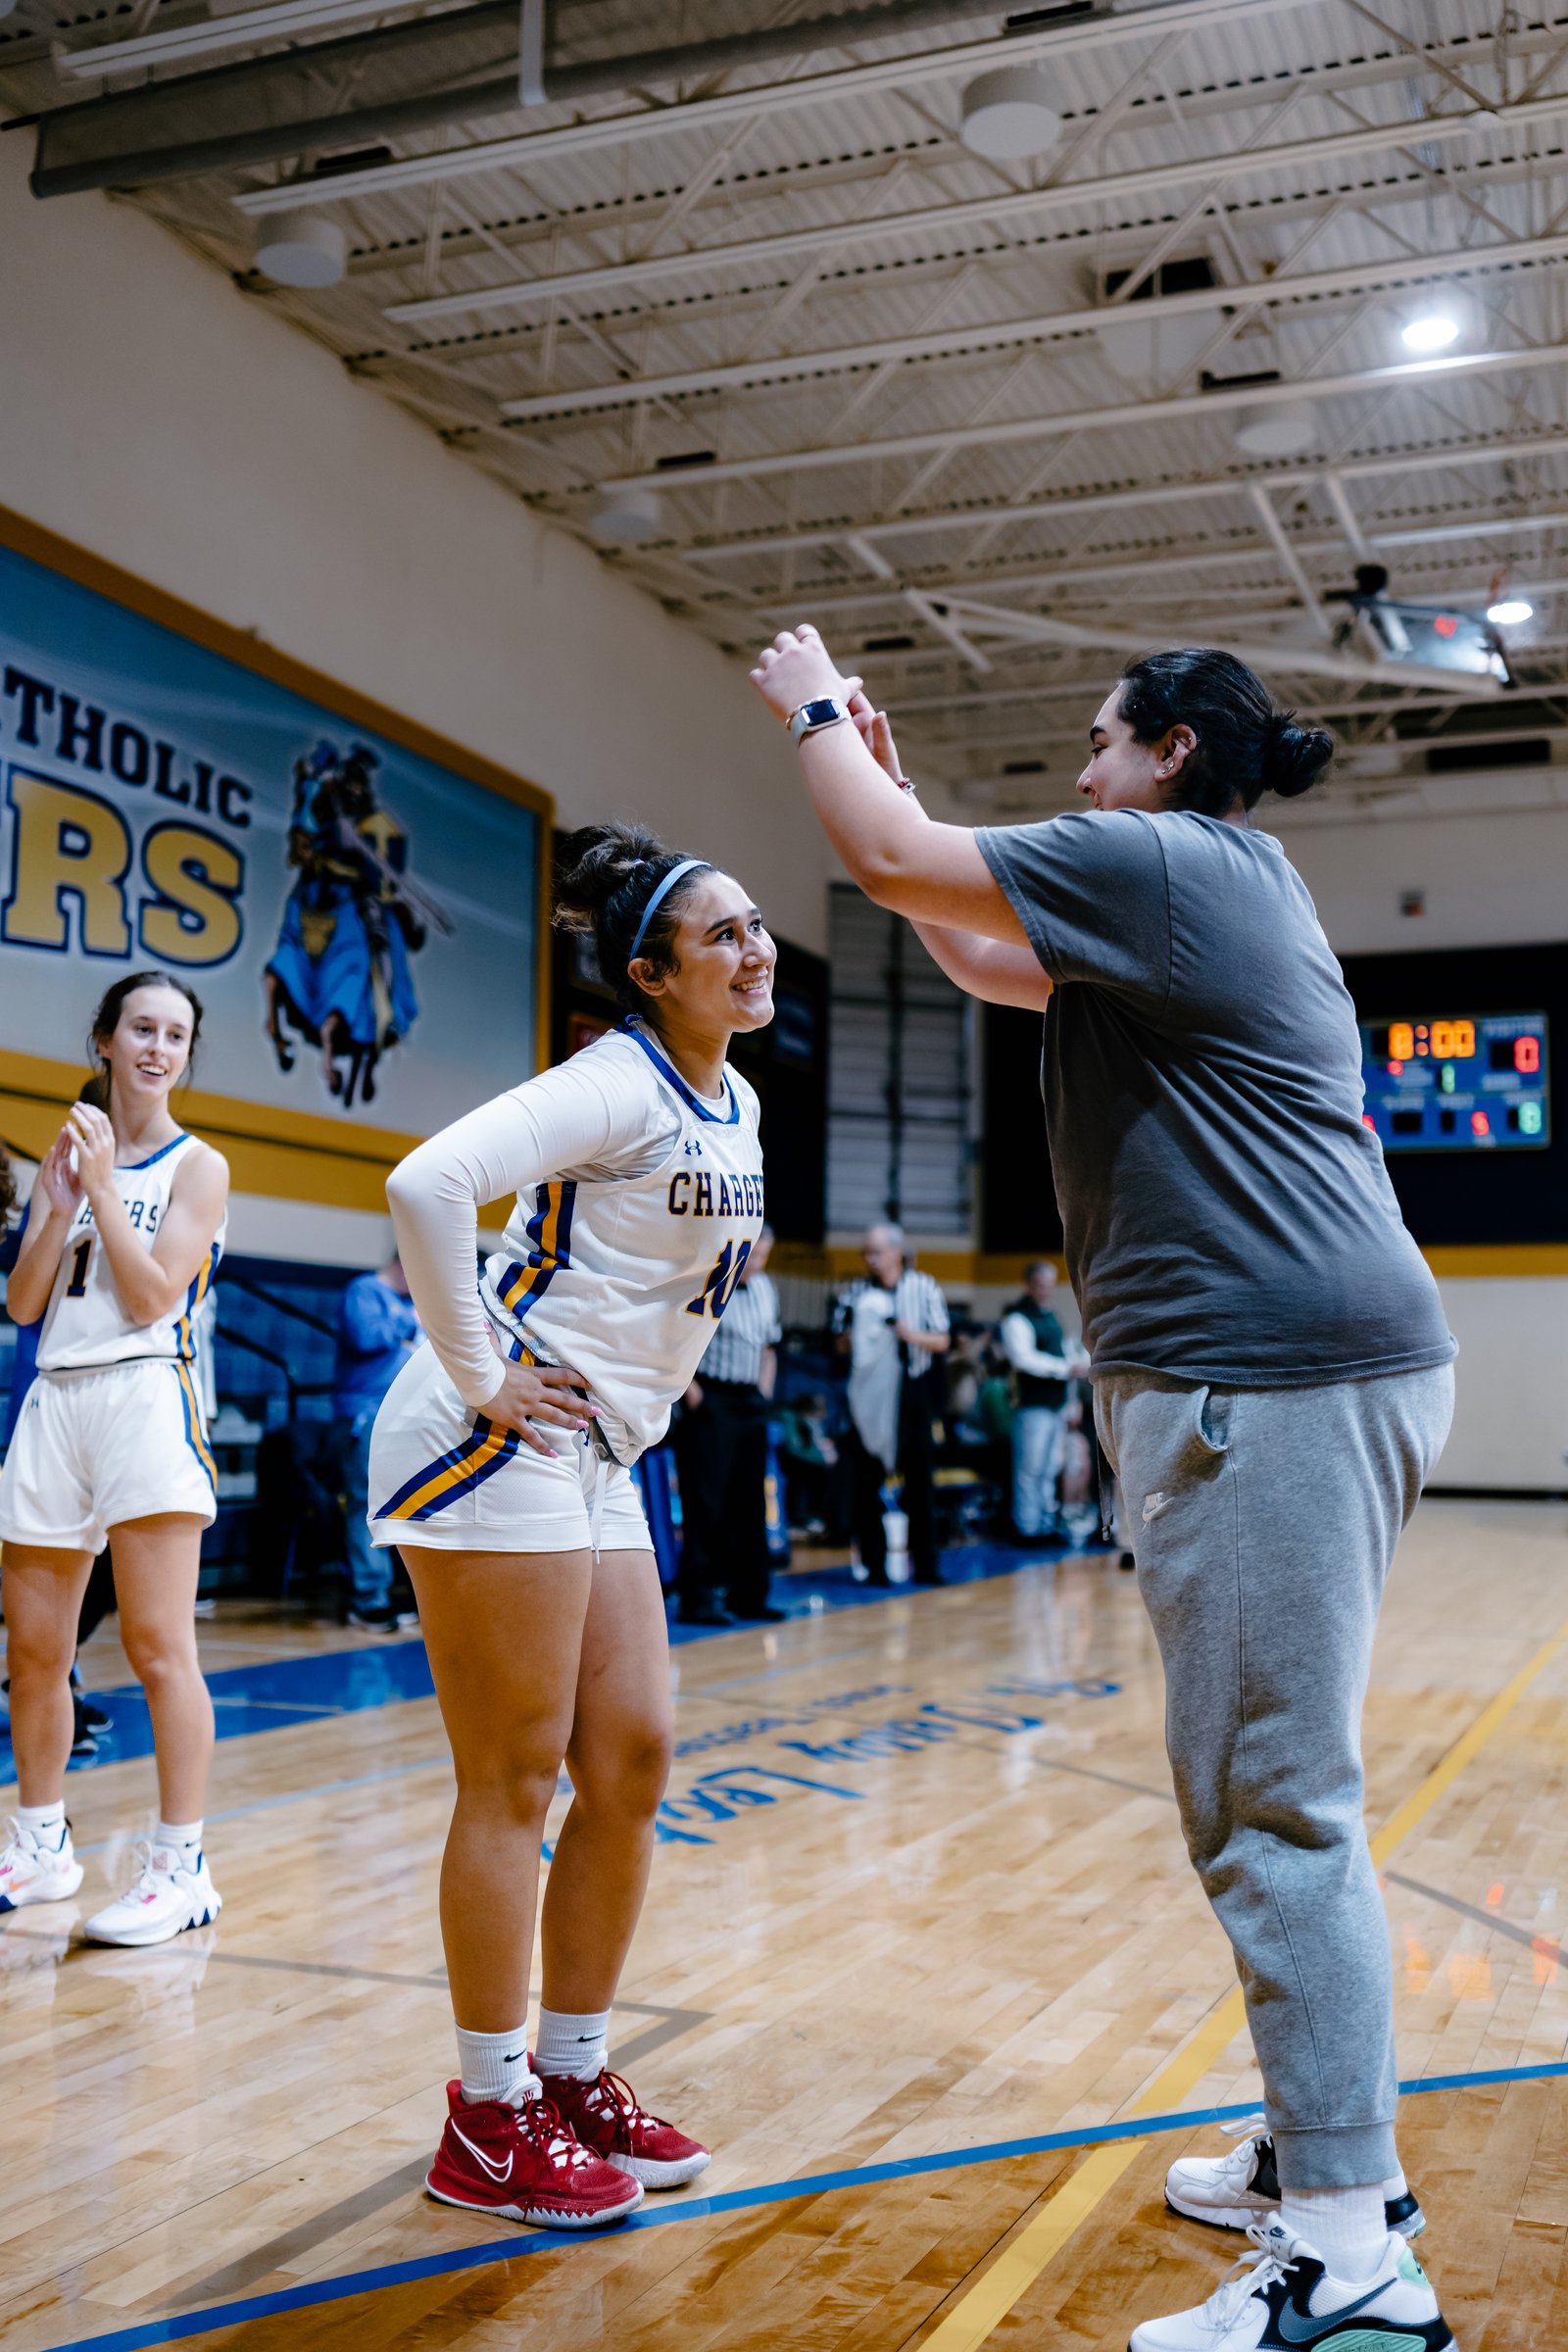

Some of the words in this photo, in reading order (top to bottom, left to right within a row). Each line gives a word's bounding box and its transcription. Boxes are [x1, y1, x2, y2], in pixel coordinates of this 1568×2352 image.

[1, 663, 253, 829] THOLIC
[0, 761, 246, 969] RS
[668, 1172, 764, 1217] CHARGE
[685, 1238, 753, 1320] 10
